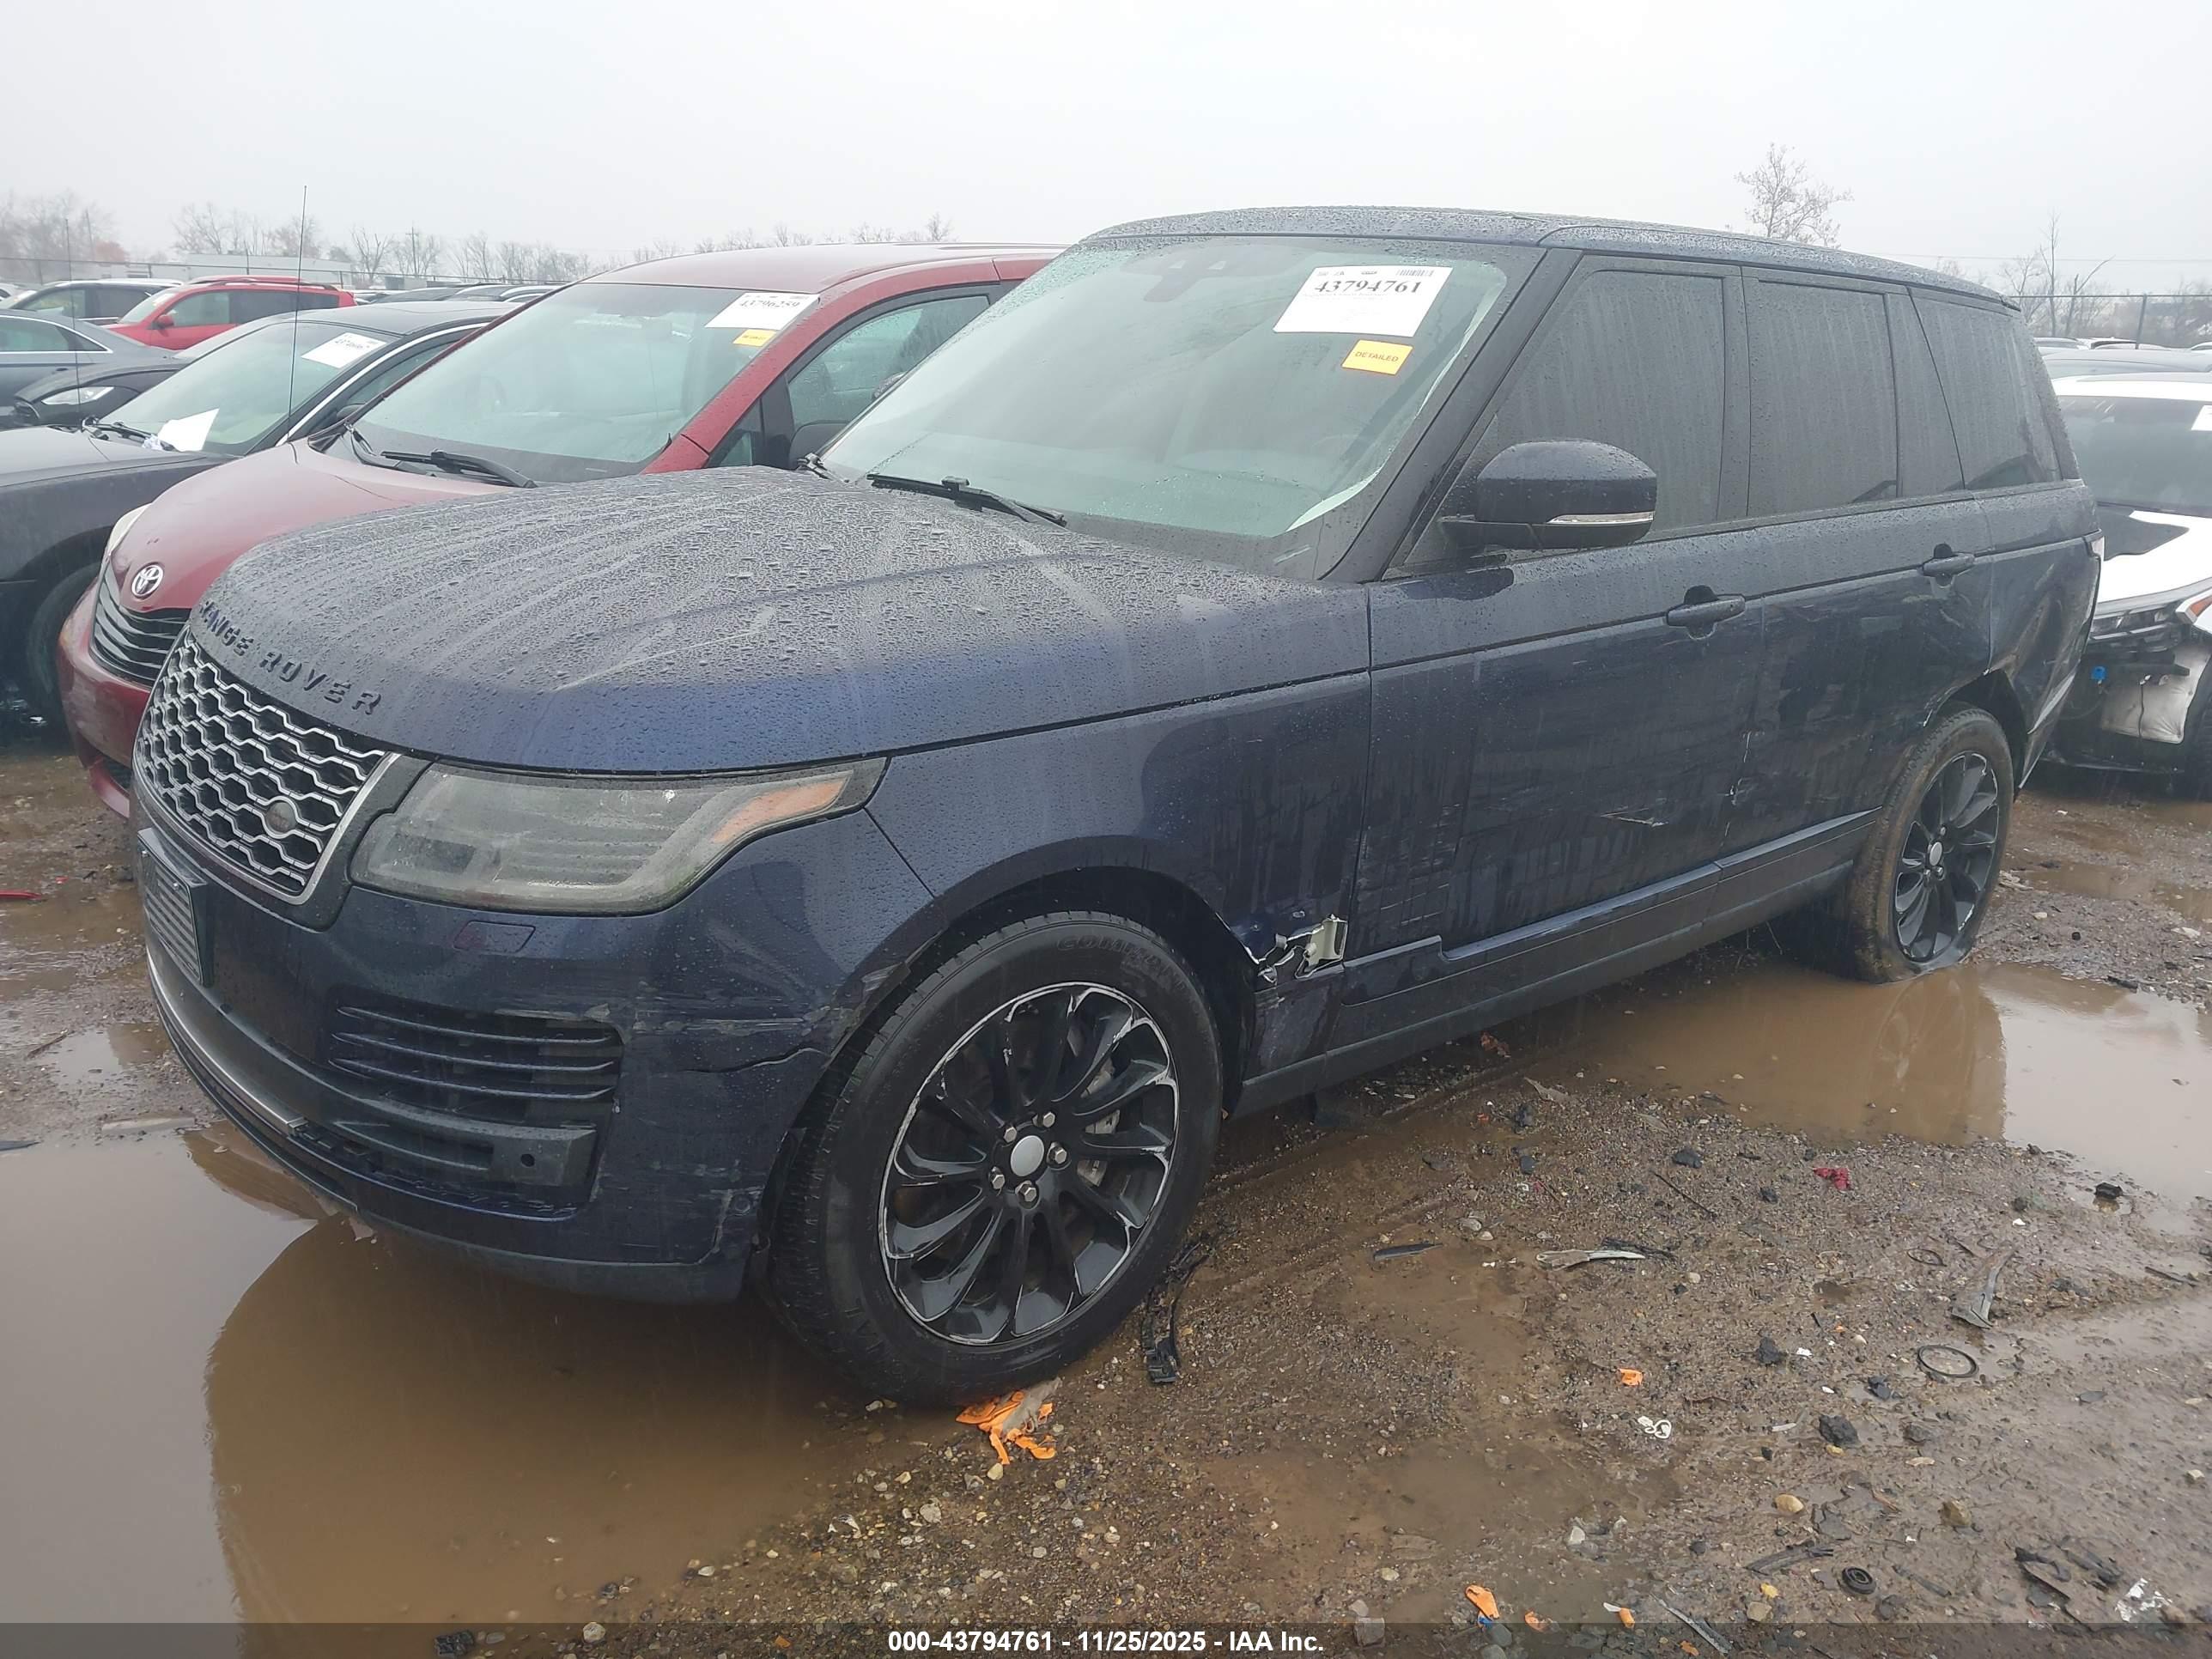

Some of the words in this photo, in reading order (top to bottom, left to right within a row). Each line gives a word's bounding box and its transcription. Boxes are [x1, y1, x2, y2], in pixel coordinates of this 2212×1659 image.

[1315, 279, 1422, 294] 43794761
[1355, 350, 1400, 362] DETAILED
[199, 601, 255, 657] RANGE
[259, 652, 382, 715] ROVER
